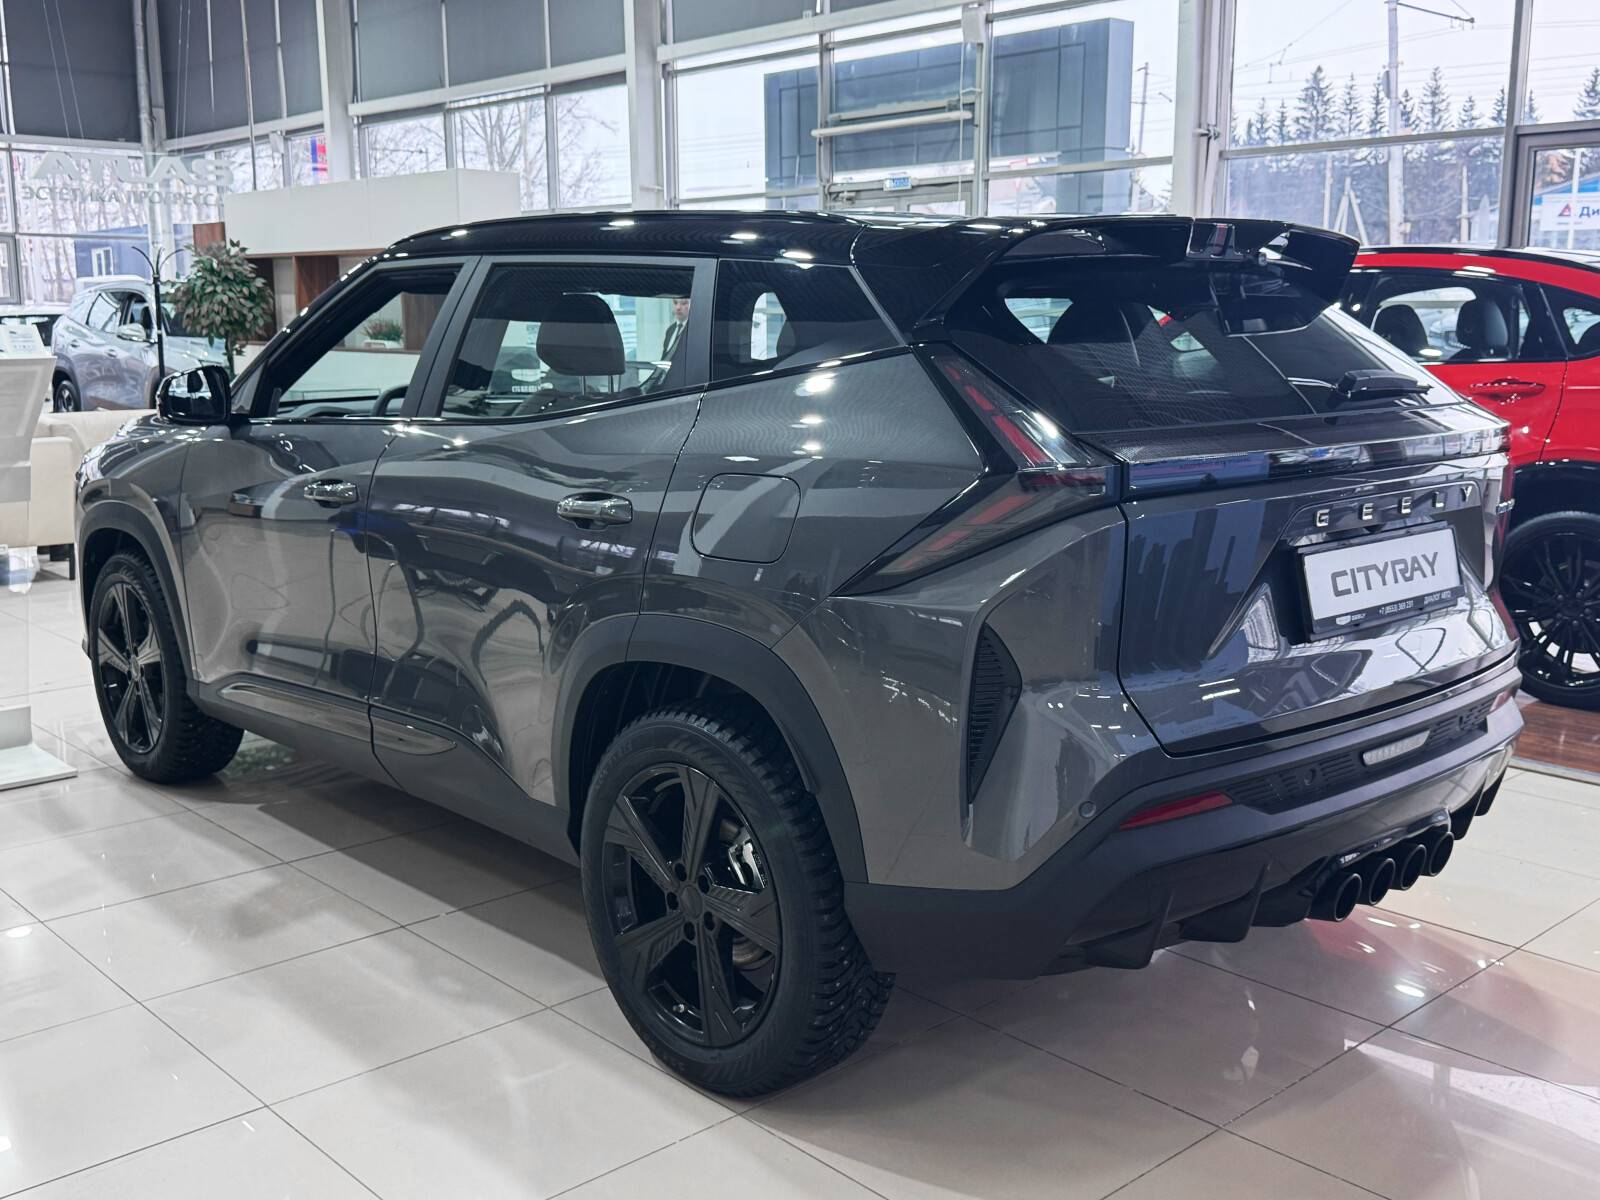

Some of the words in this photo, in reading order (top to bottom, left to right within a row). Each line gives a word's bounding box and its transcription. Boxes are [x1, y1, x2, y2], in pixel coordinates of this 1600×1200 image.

[32, 151, 233, 185] ATLAS
[21, 185, 119, 203] ЭСТЕТИКА
[1316, 486, 1472, 527] GEELY
[1330, 551, 1439, 598] CITYRAY
